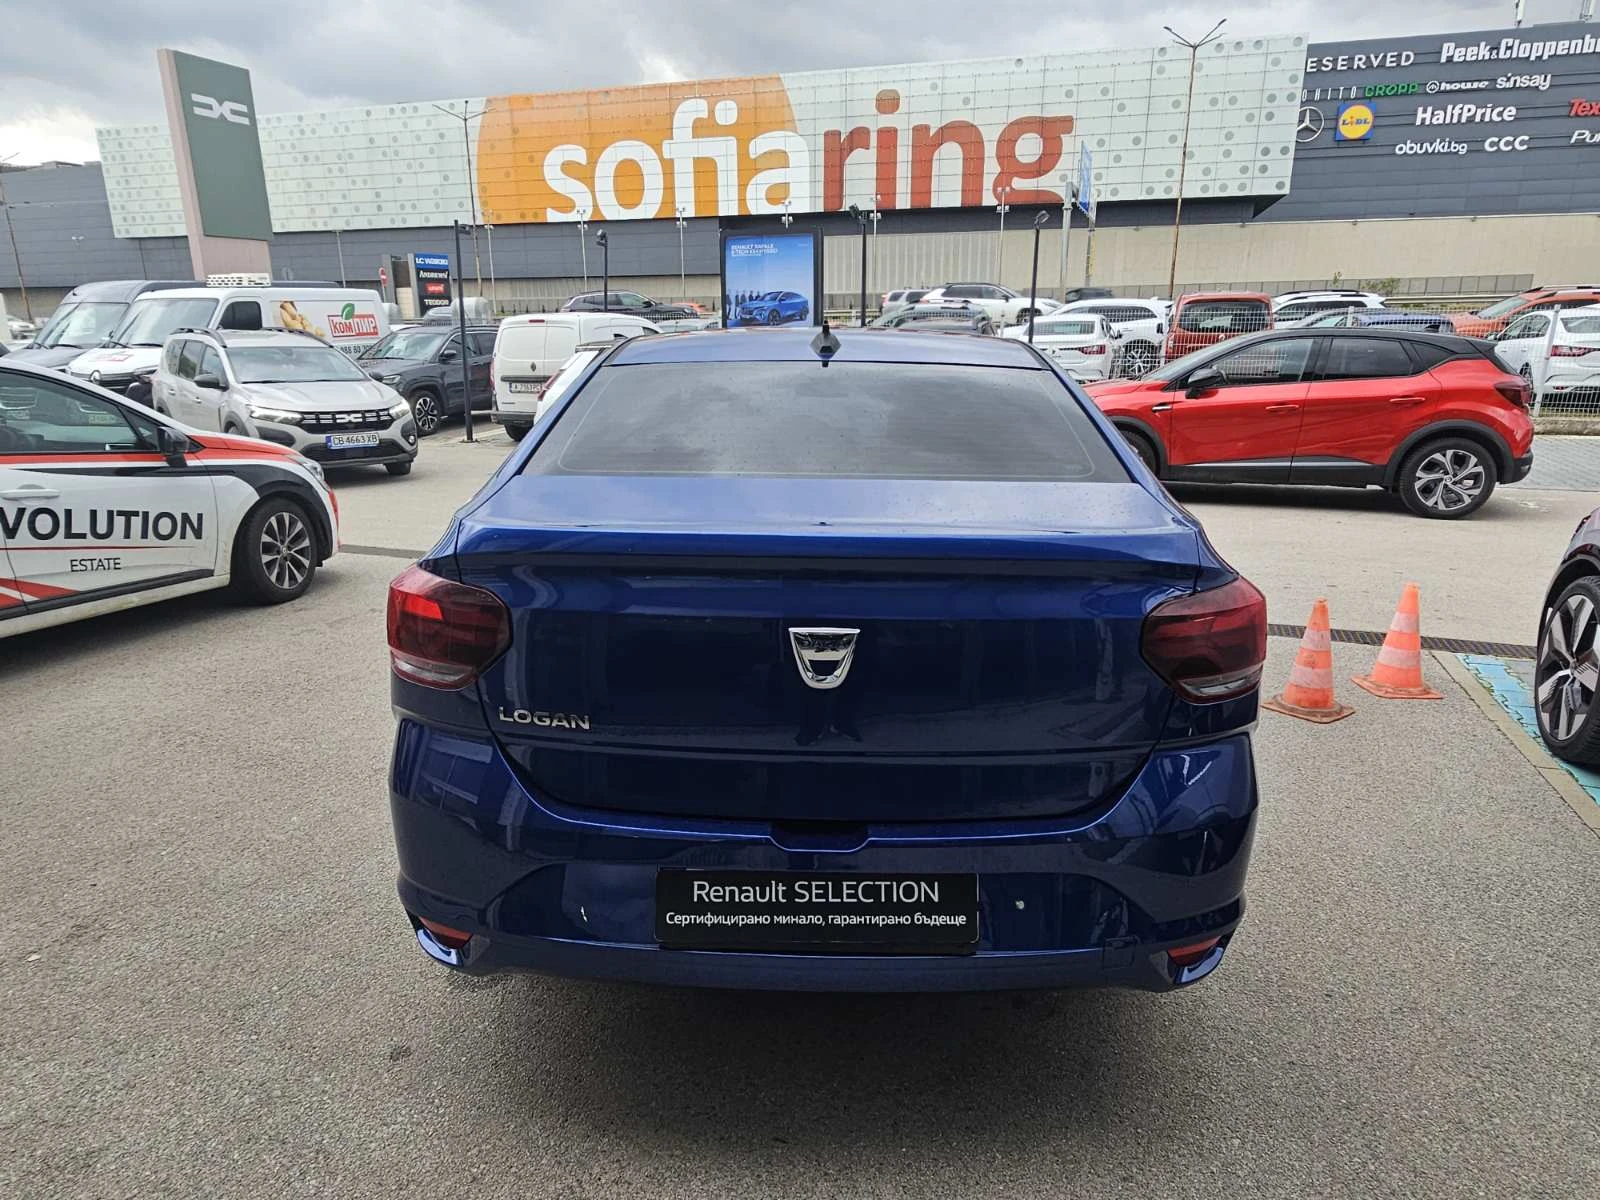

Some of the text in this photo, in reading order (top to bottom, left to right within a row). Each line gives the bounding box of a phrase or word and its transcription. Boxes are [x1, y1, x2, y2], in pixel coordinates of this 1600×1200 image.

[1364, 82, 1419, 98] CROPP
[1495, 72, 1552, 91] sinsay
[1415, 103, 1517, 126] HalfPrice
[1395, 138, 1468, 155] obuvki.bg
[1483, 134, 1531, 152] CCC
[0, 506, 204, 541] VOLUTION
[70, 557, 122, 572] ESTATE
[499, 706, 590, 730] LOGAN
[693, 880, 939, 903] Renault SELECTION
[665, 911, 967, 928] Сертифицирано минало, гарантирано бъдеще
